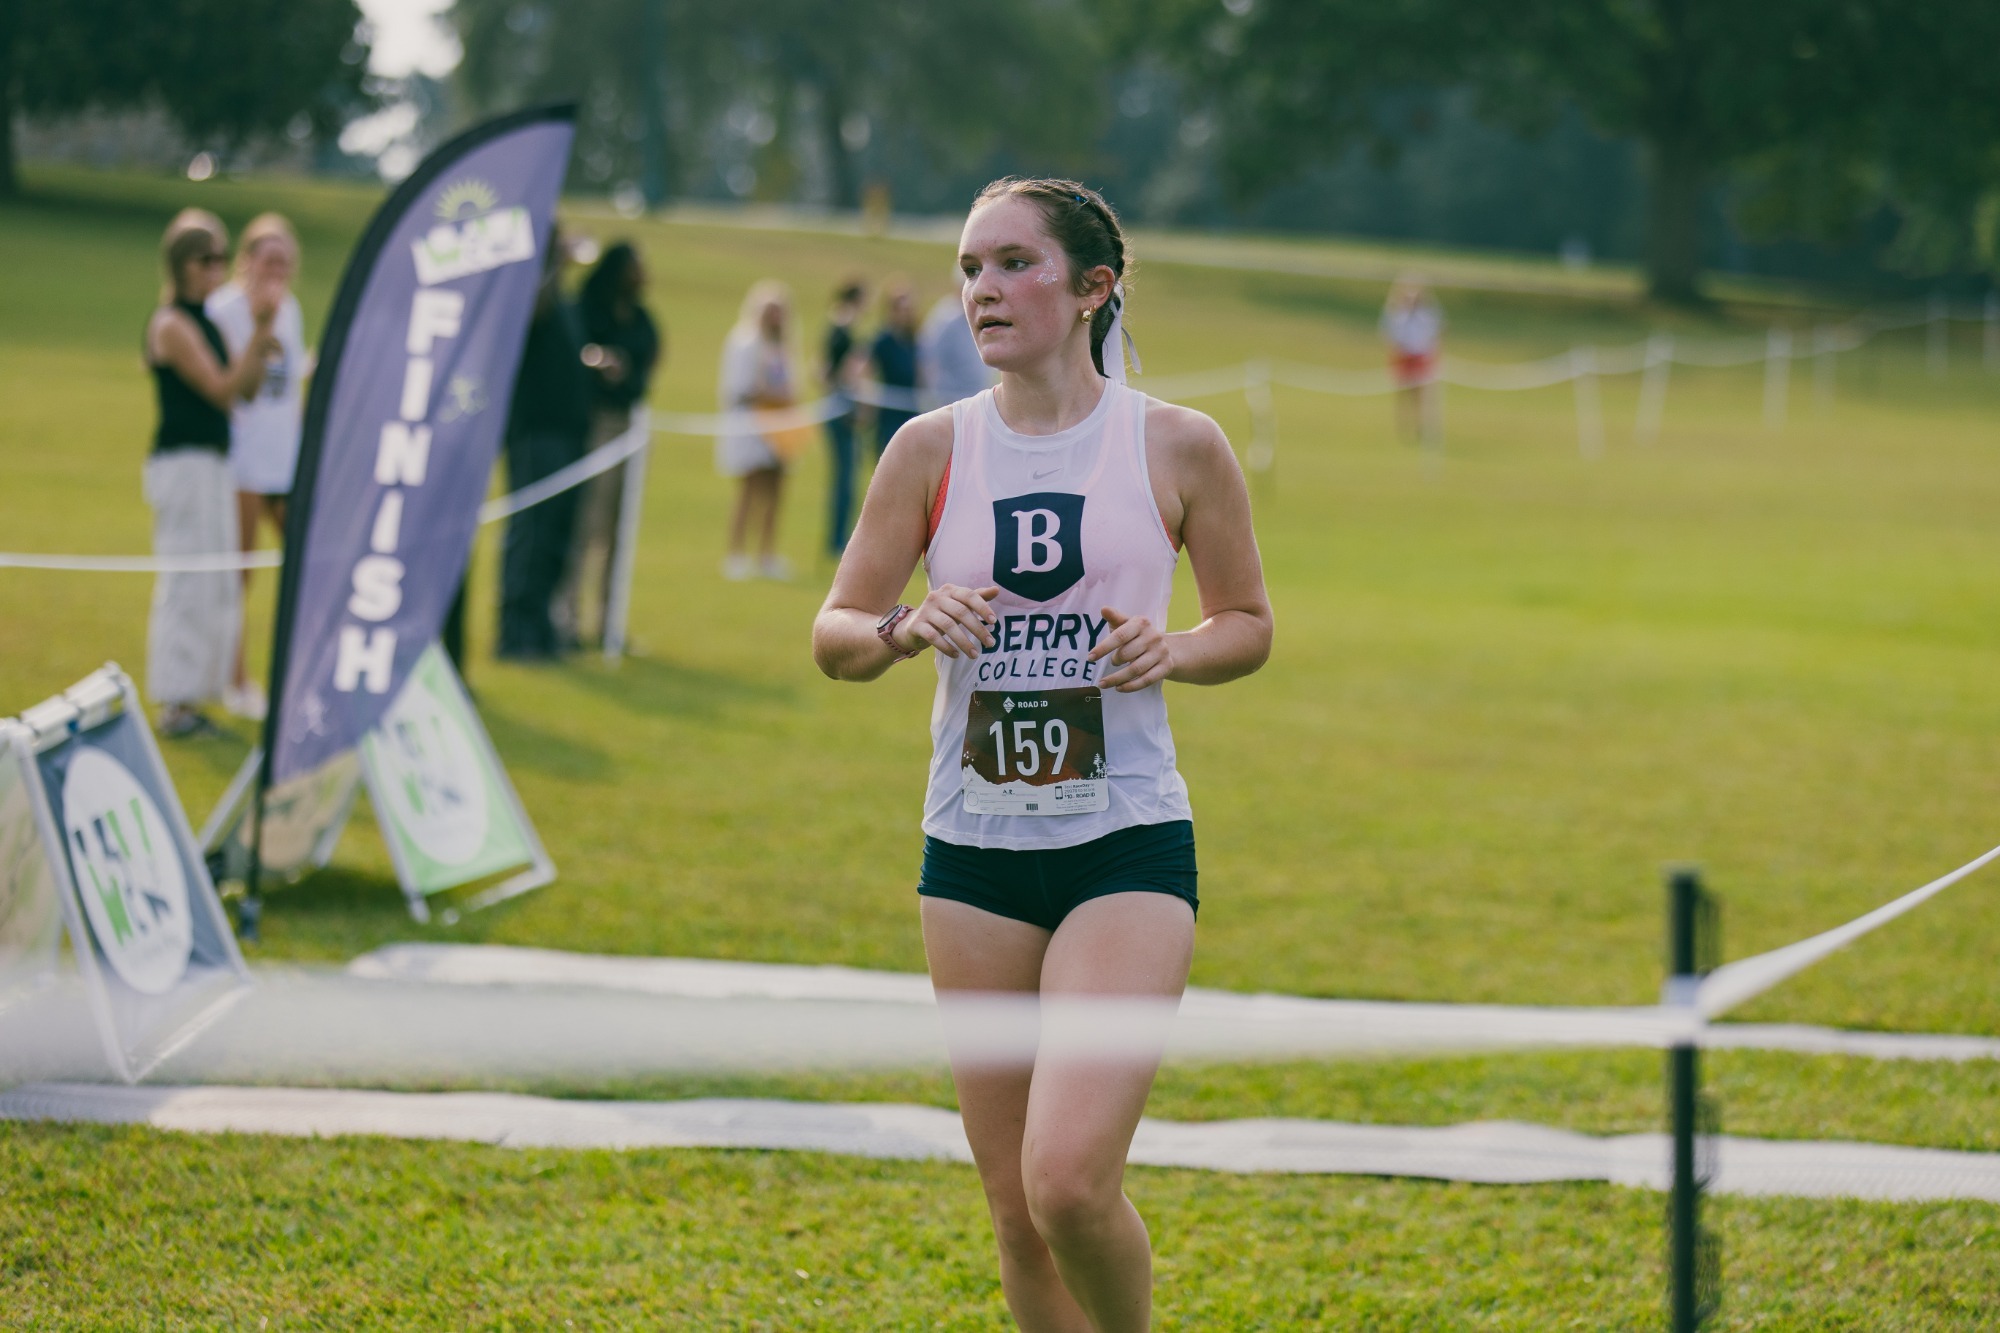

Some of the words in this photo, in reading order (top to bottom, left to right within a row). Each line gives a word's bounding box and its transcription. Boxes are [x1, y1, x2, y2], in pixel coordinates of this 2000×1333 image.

[333, 287, 466, 695] FINISH
[1011, 508, 1063, 574] B
[980, 613, 1108, 654] BERRY
[978, 657, 1097, 682] COLLEGE
[989, 718, 1069, 777] 159
